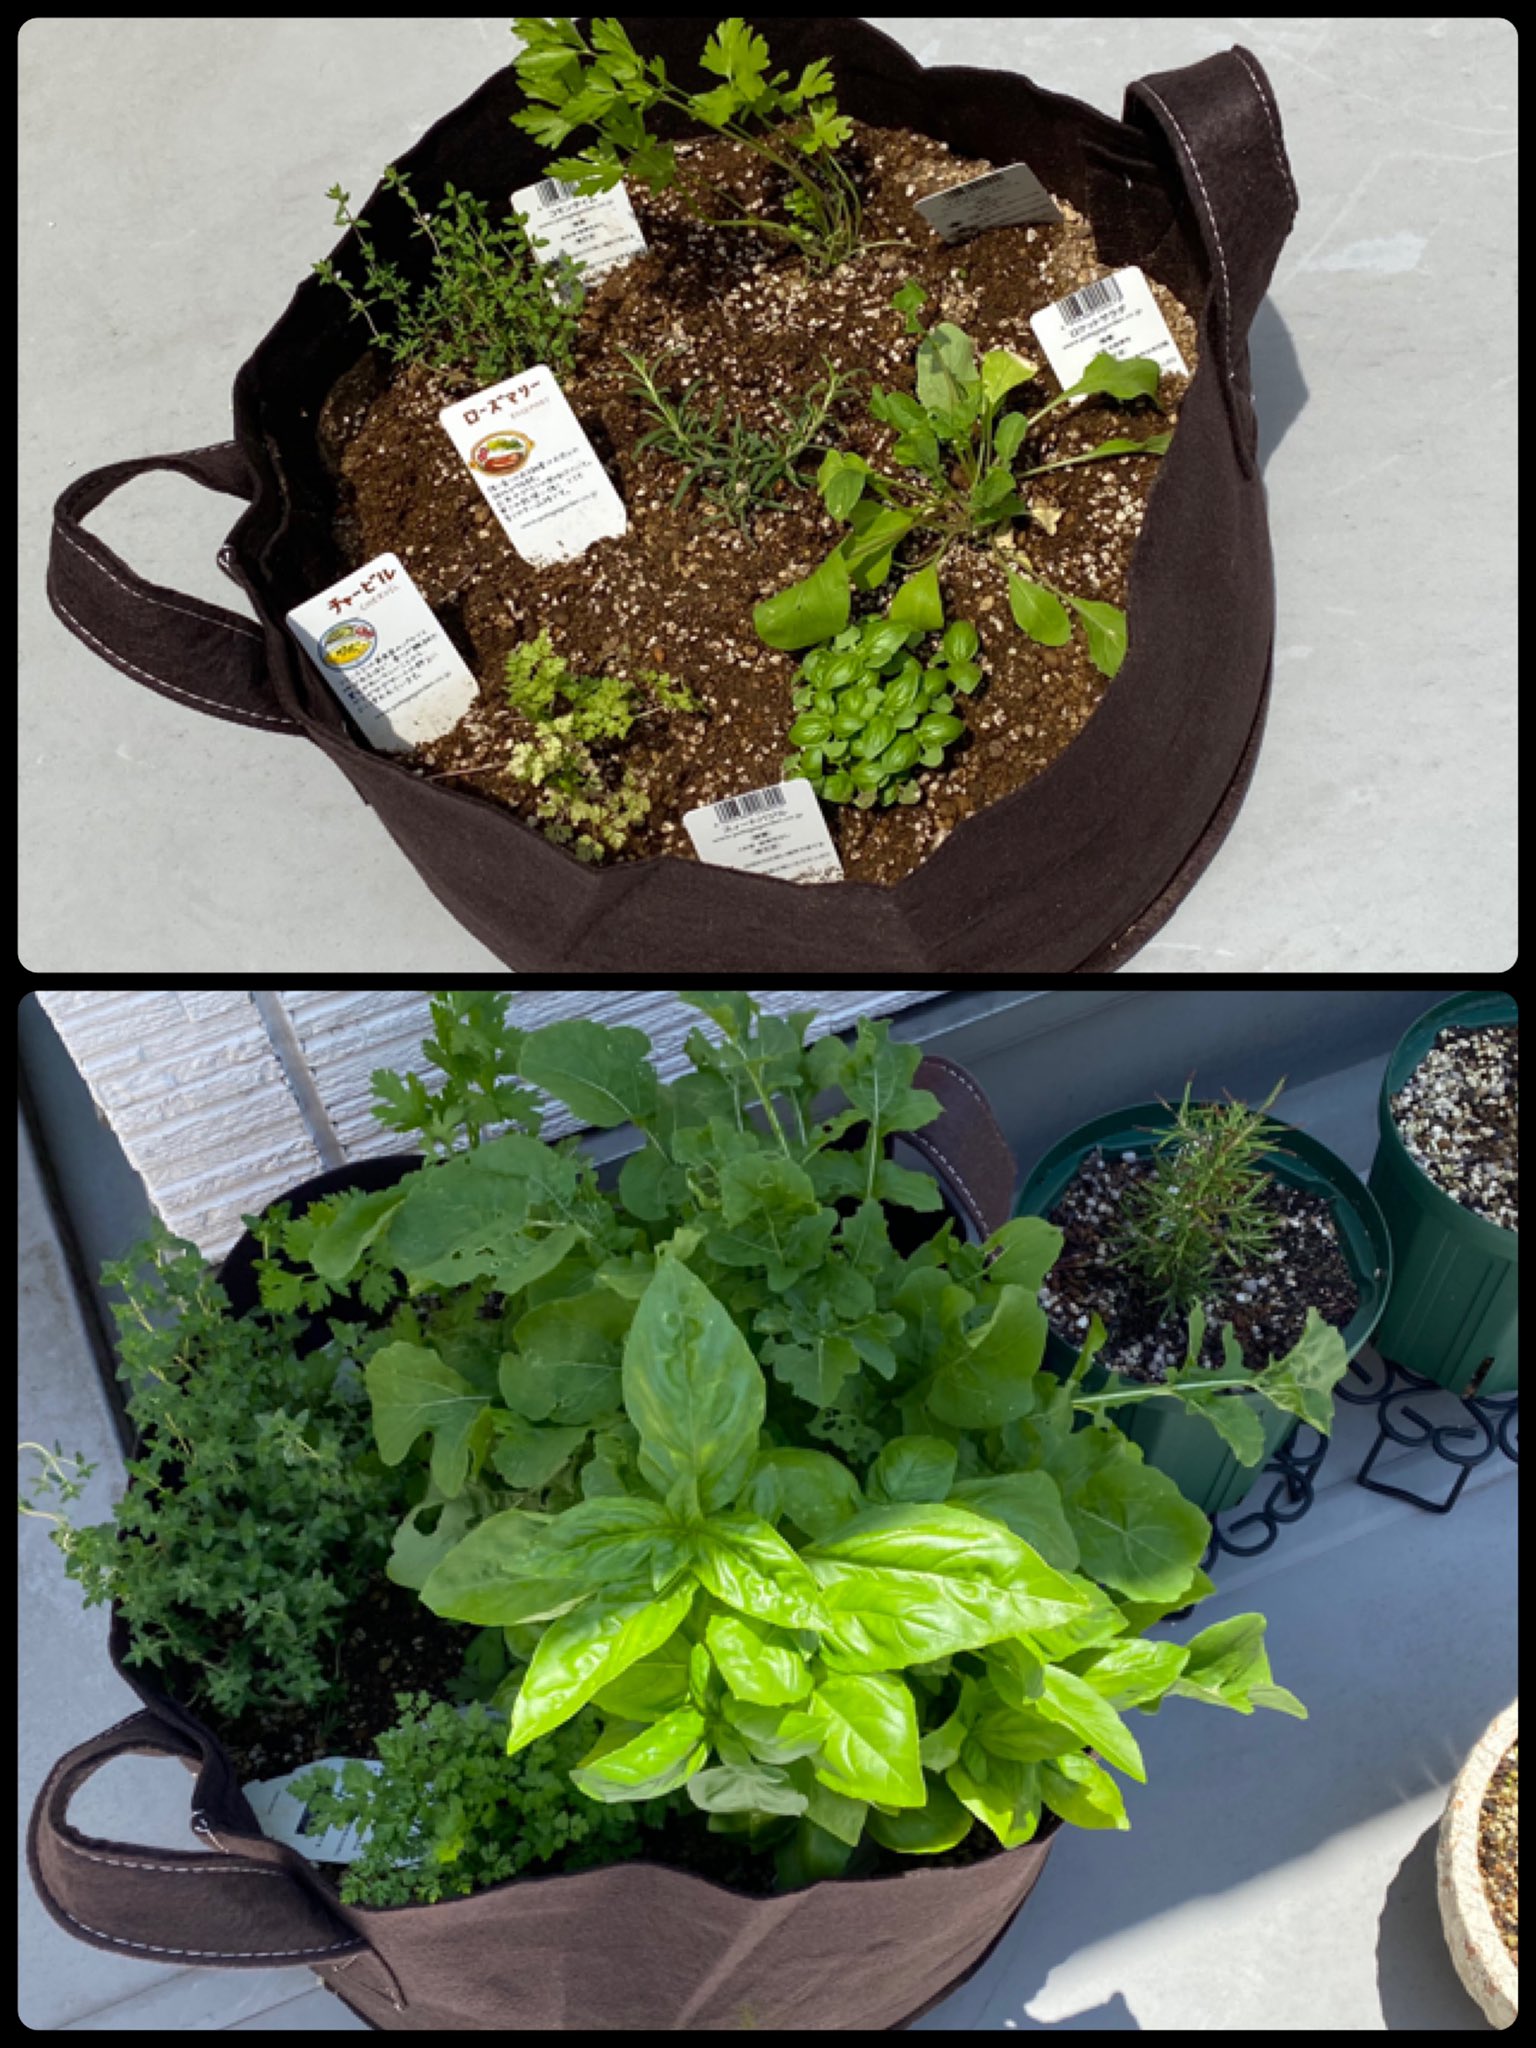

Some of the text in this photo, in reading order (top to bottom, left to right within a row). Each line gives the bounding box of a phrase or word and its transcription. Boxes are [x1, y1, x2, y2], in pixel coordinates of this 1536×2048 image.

[463, 381, 540, 426] ローズマリー
[328, 569, 396, 614] チャービル
